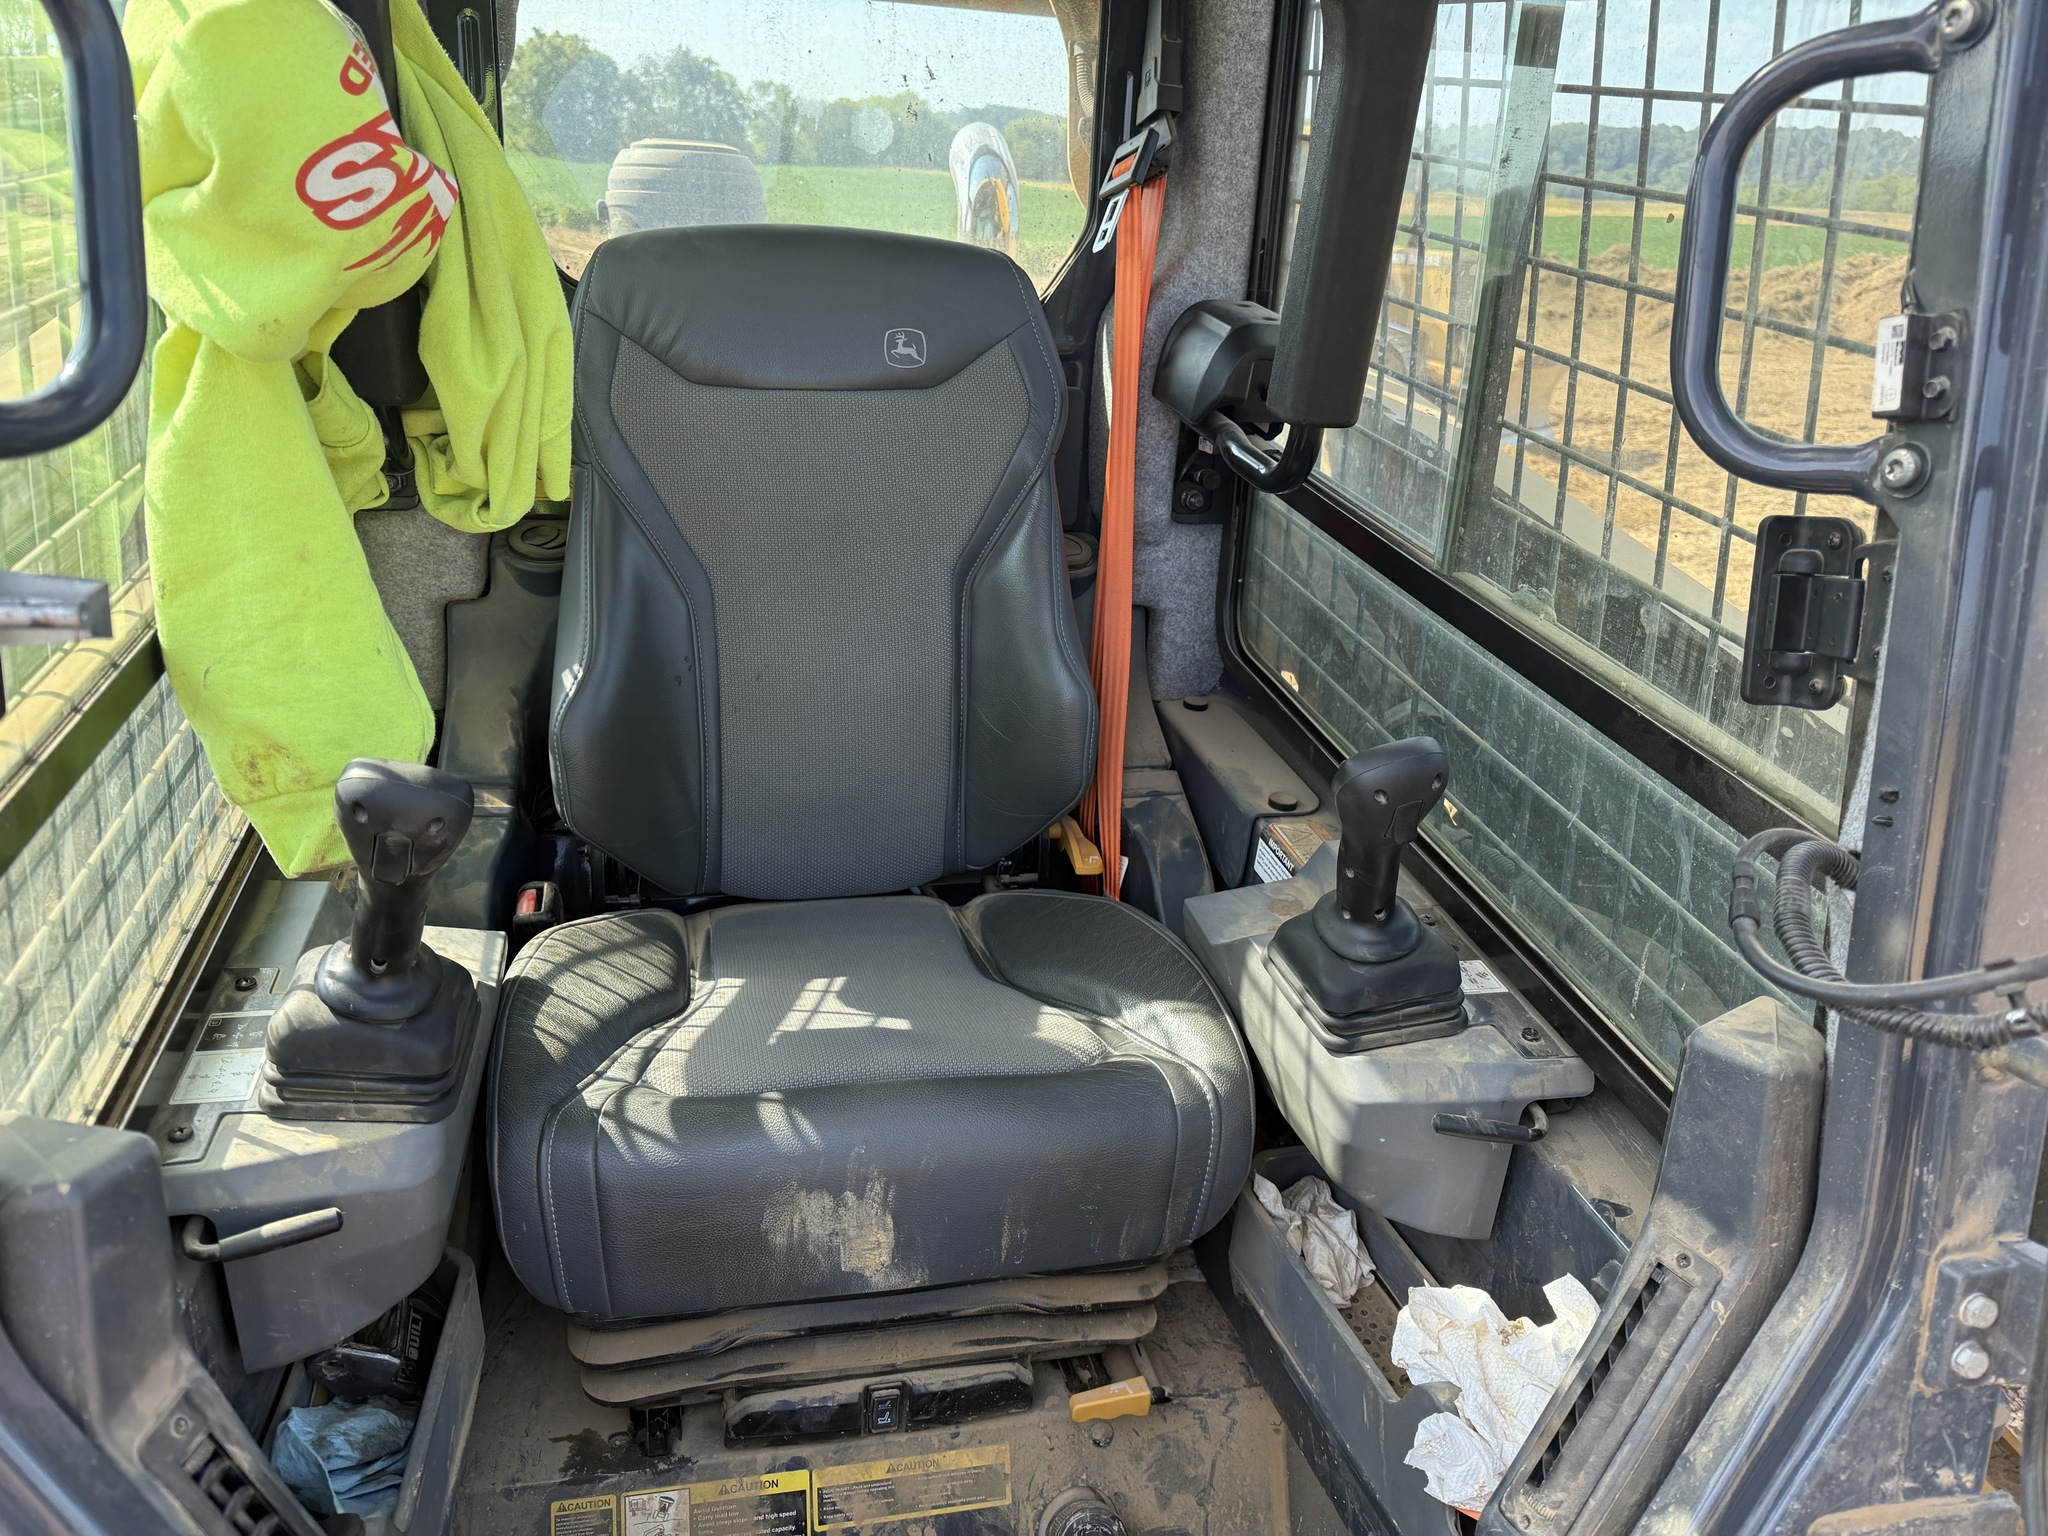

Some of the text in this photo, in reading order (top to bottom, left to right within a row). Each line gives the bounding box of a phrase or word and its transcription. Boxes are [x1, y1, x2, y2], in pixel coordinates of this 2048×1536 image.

[1268, 838, 1295, 872] IMPORTANT
[407, 1308, 423, 1361] BUILT
[896, 1458, 940, 1472] CAUTION
[730, 1479, 779, 1494] CAUTION
[567, 1498, 611, 1511] CAUTION
[765, 1512, 778, 1520] high
[779, 1510, 797, 1518] speed
[771, 1525, 797, 1533] capacity.
